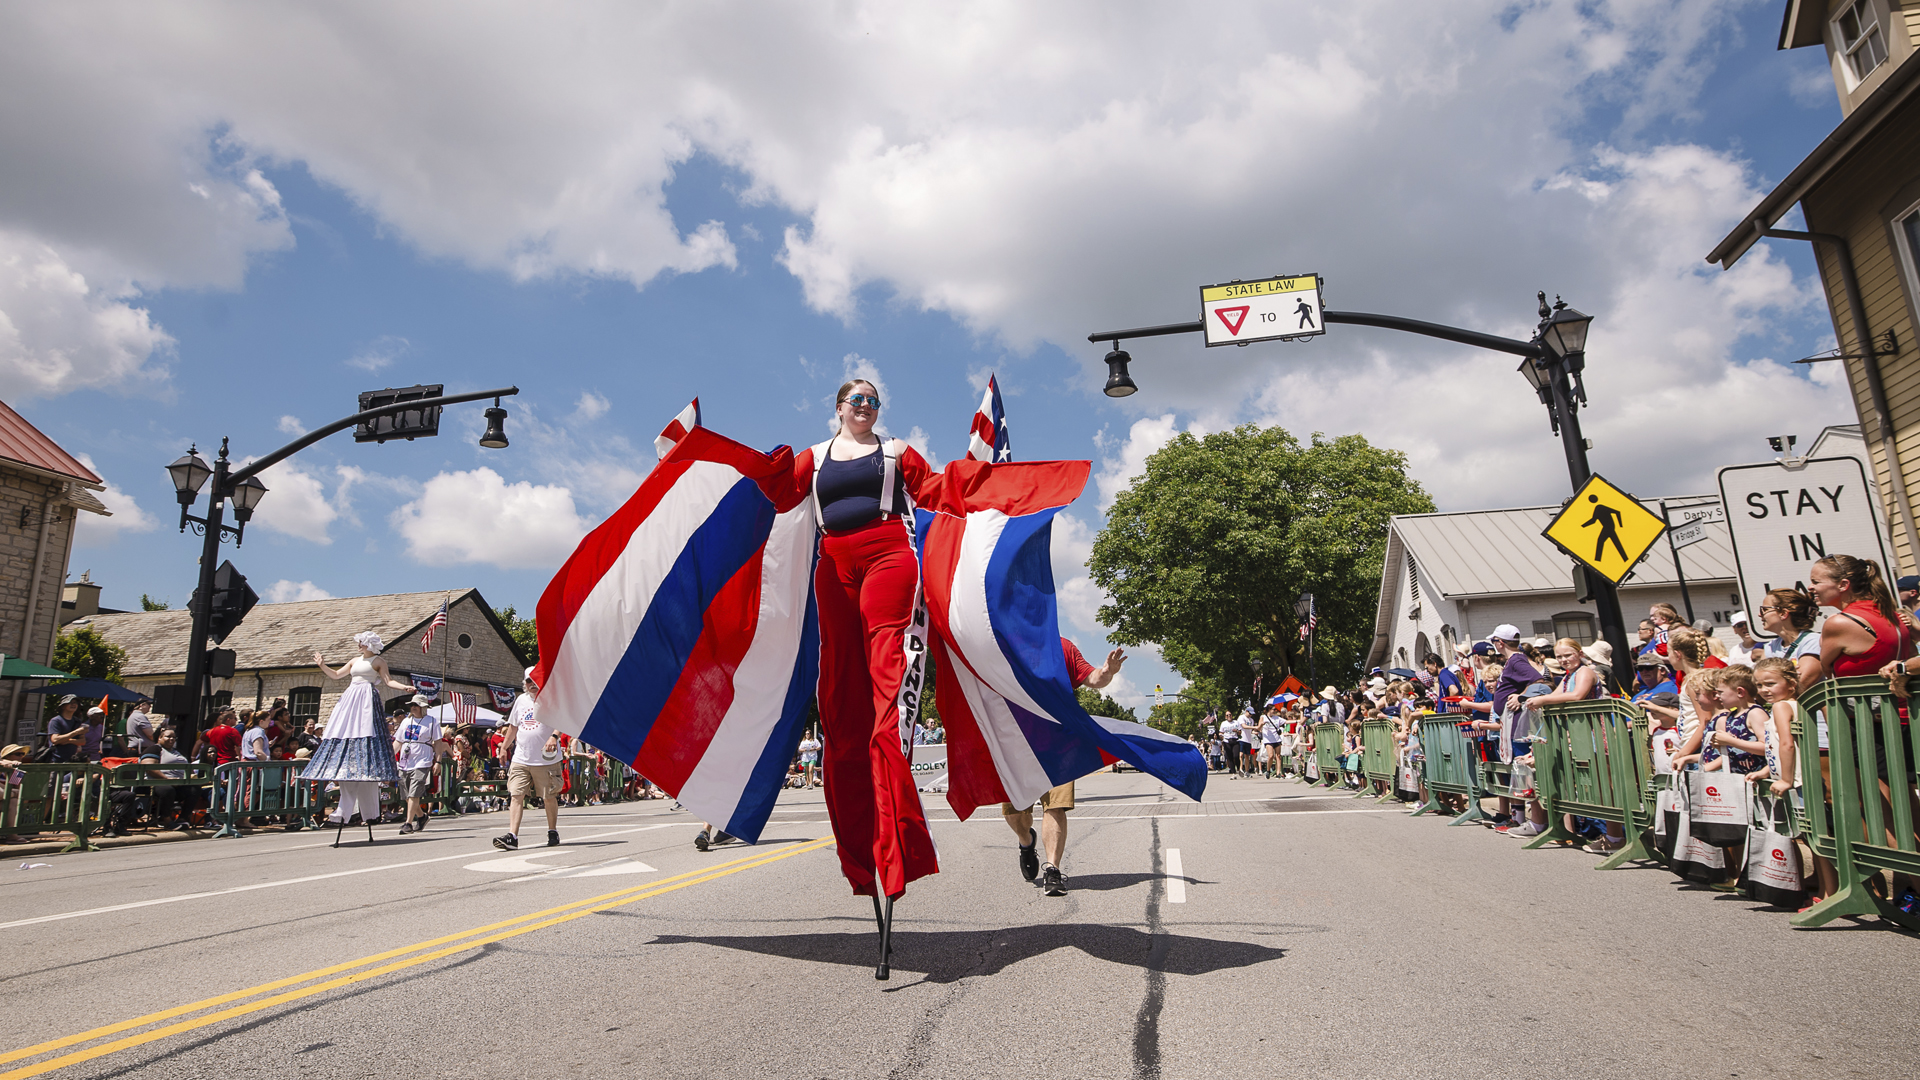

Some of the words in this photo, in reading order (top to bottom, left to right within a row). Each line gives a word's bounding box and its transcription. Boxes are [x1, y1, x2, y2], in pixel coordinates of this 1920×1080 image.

[1226, 283, 1262, 296] STATE
[1268, 279, 1295, 292] LAW
[1260, 312, 1277, 323] TO
[1746, 484, 1845, 520] STAY
[1684, 510, 1713, 520] Darby
[1716, 507, 1723, 516] S
[1680, 529, 1696, 541] Bridge
[1695, 526, 1702, 535] St
[1788, 532, 1826, 562] IN
[902, 634, 924, 729] DANCE
[911, 762, 946, 771] COOLEY
